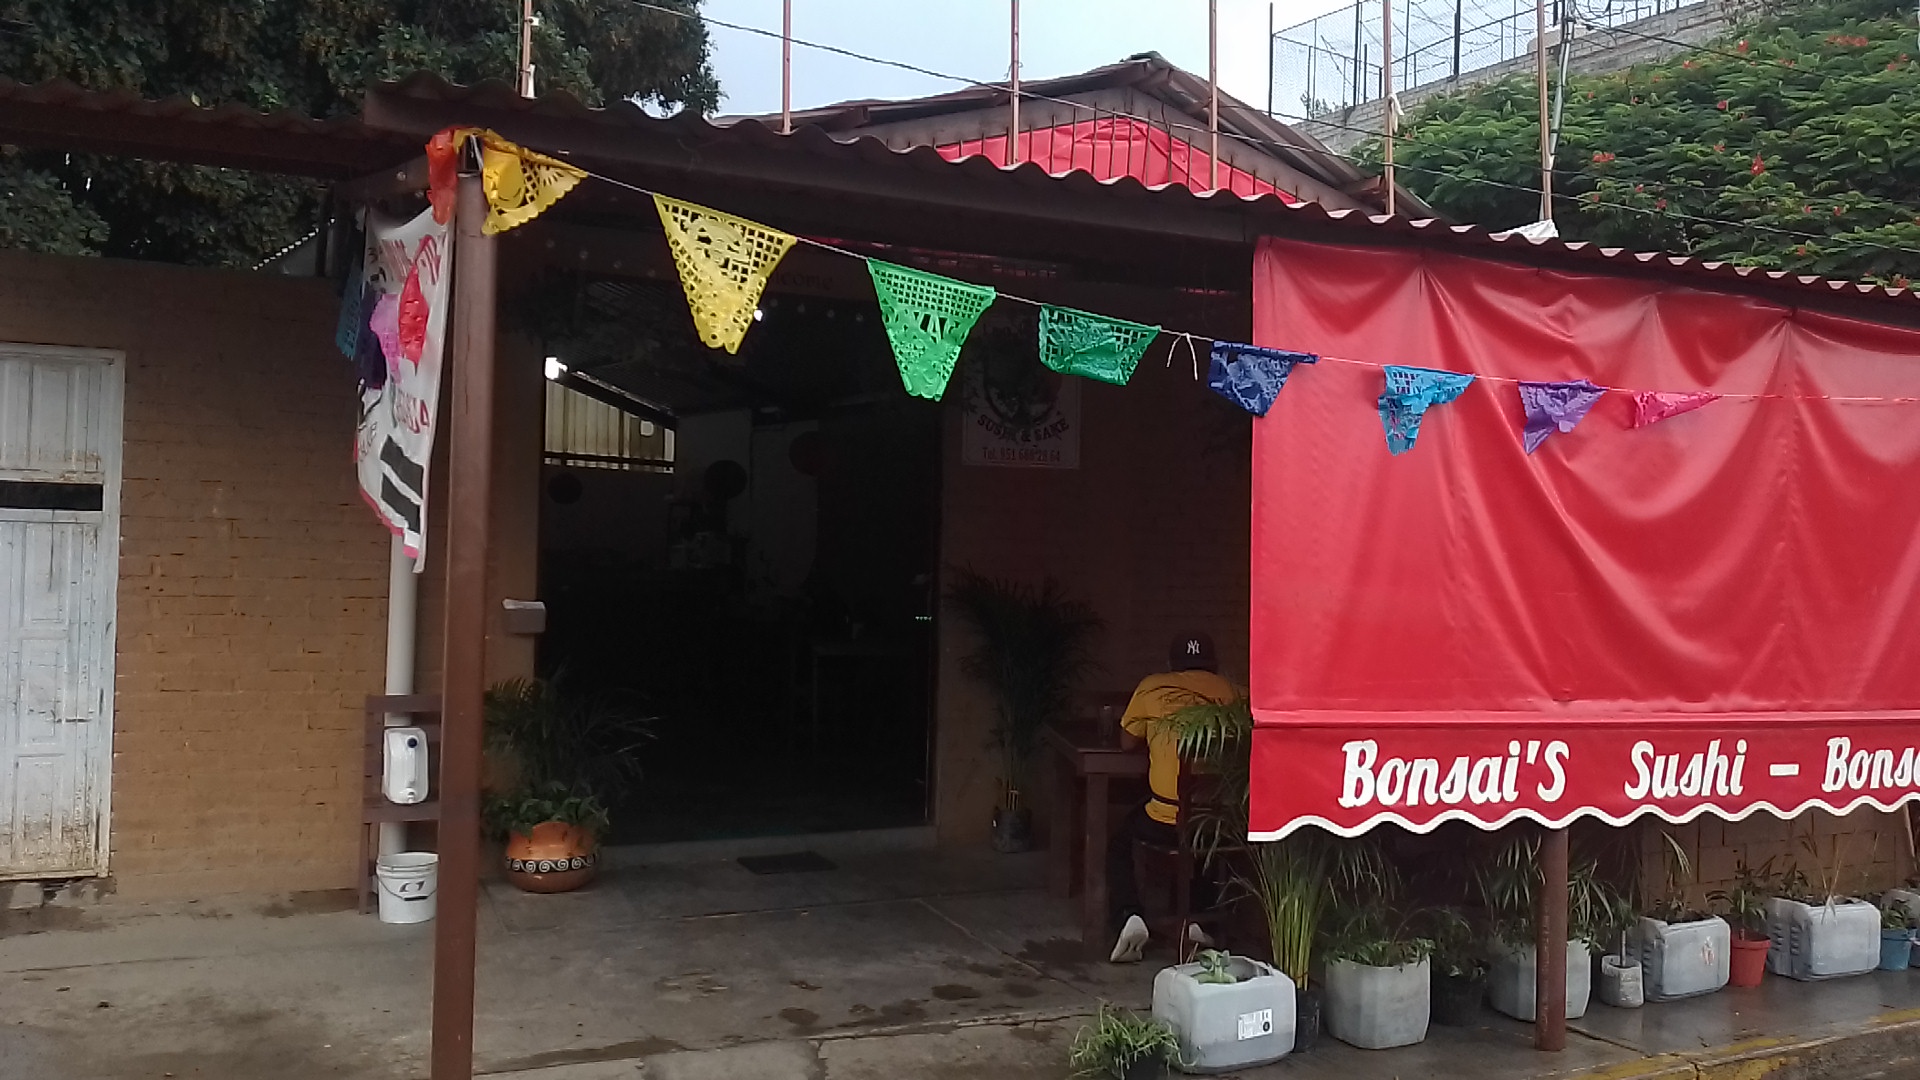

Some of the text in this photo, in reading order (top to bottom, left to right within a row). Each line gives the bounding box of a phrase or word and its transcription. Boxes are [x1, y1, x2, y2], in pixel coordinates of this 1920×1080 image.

[1020, 426, 1032, 442] &
[1186, 639, 1201, 655] NY
[1624, 739, 1747, 800] Sushi
